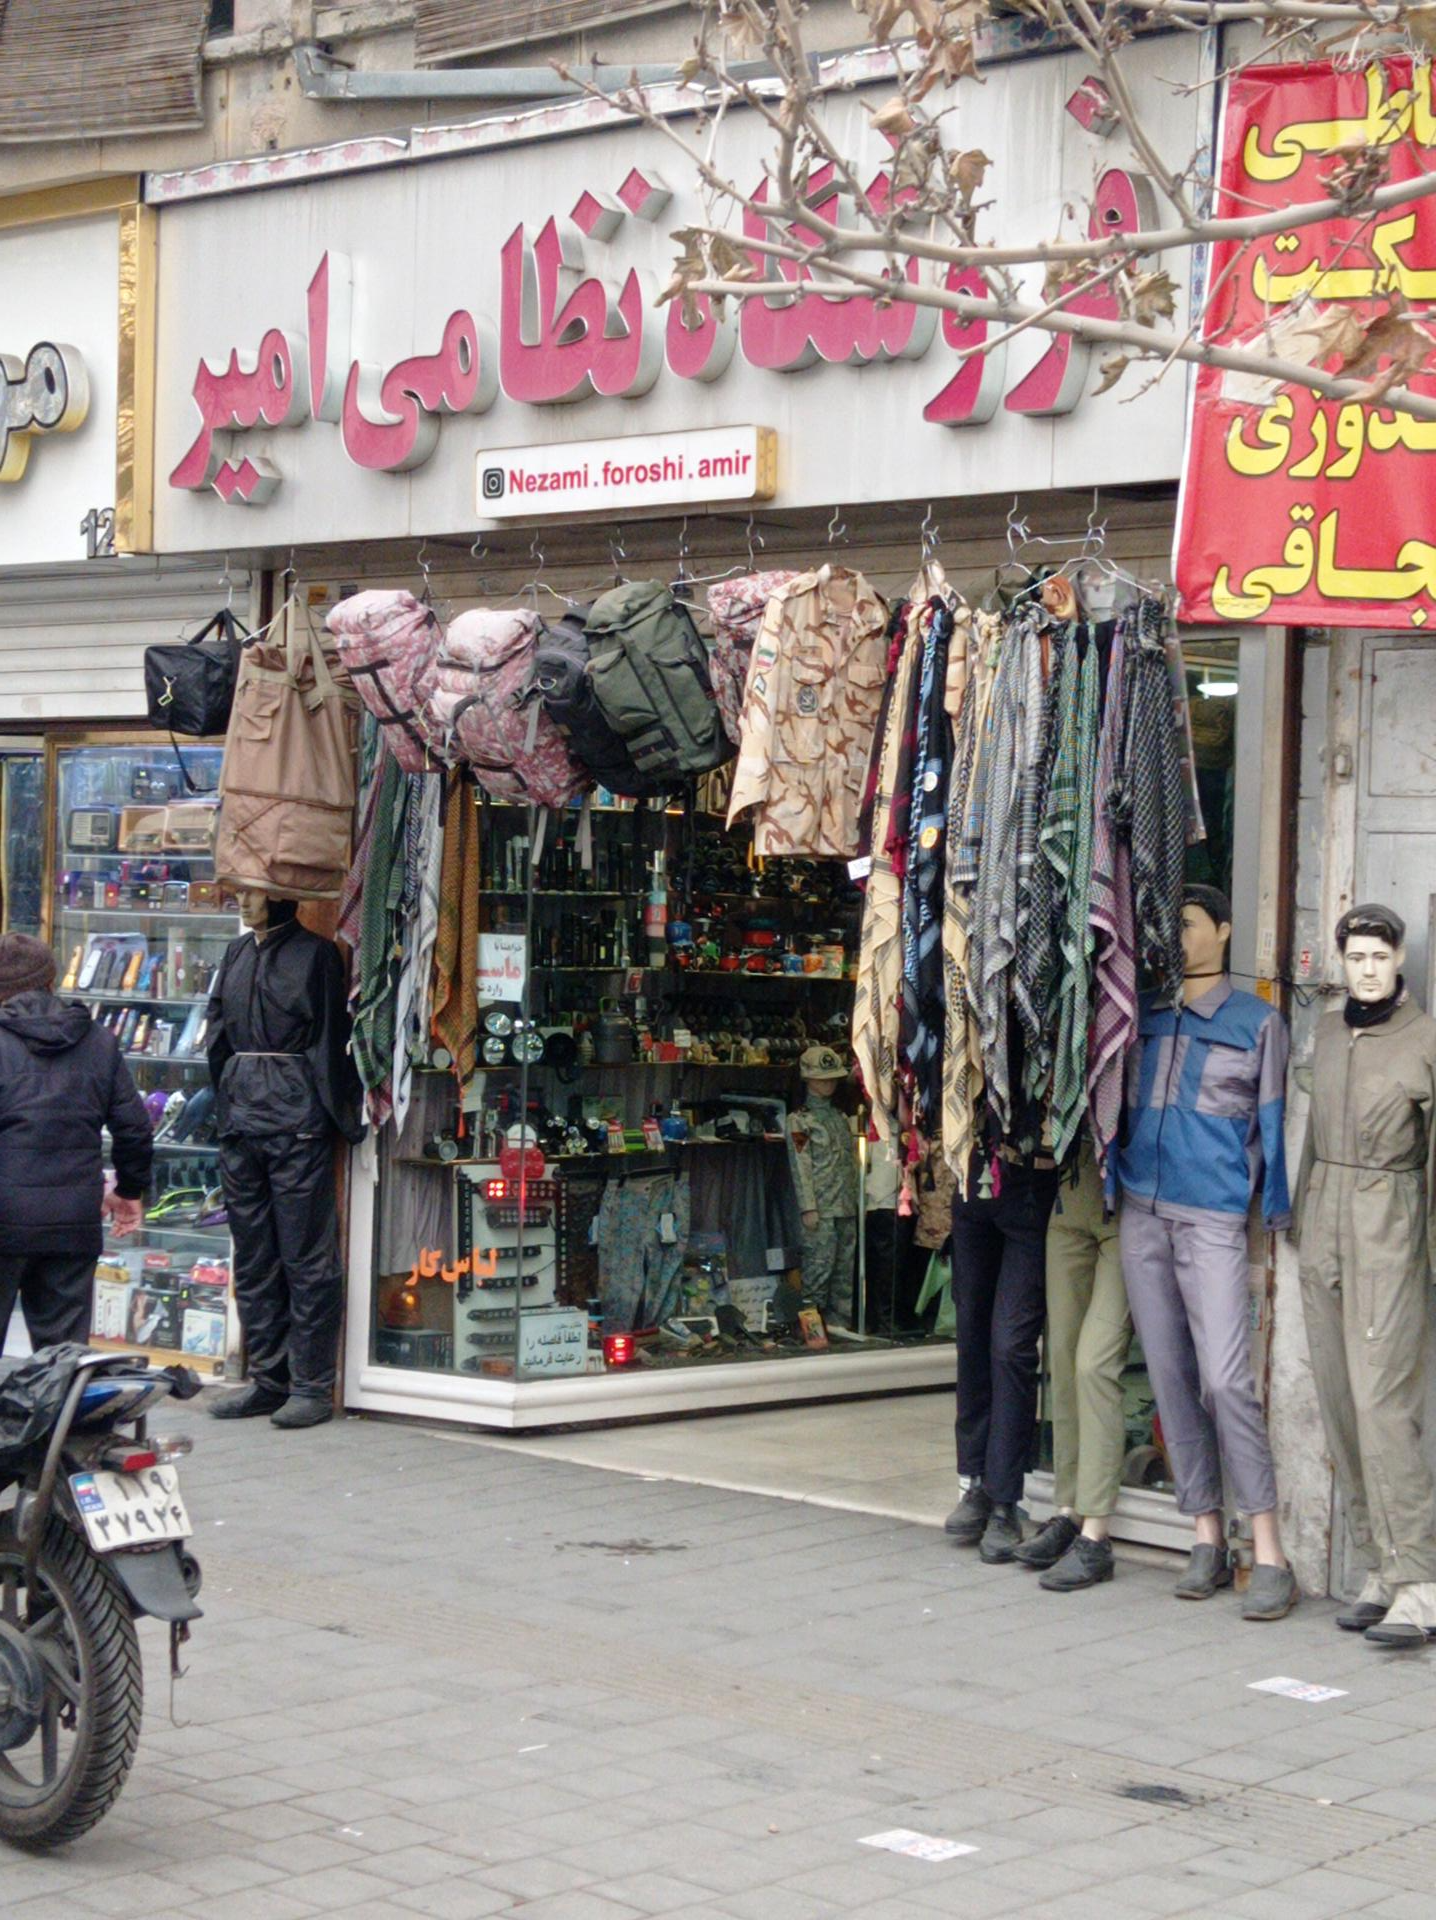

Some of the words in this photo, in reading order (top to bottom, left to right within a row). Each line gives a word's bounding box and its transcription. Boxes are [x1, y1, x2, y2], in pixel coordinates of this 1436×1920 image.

[342, 166, 659, 471] نظامی
[168, 249, 331, 504] امیر
[476, 955, 521, 979] ماس
[404, 1247, 443, 1287] کار
[440, 1247, 498, 1287] لباس
[525, 1336, 536, 1351] را
